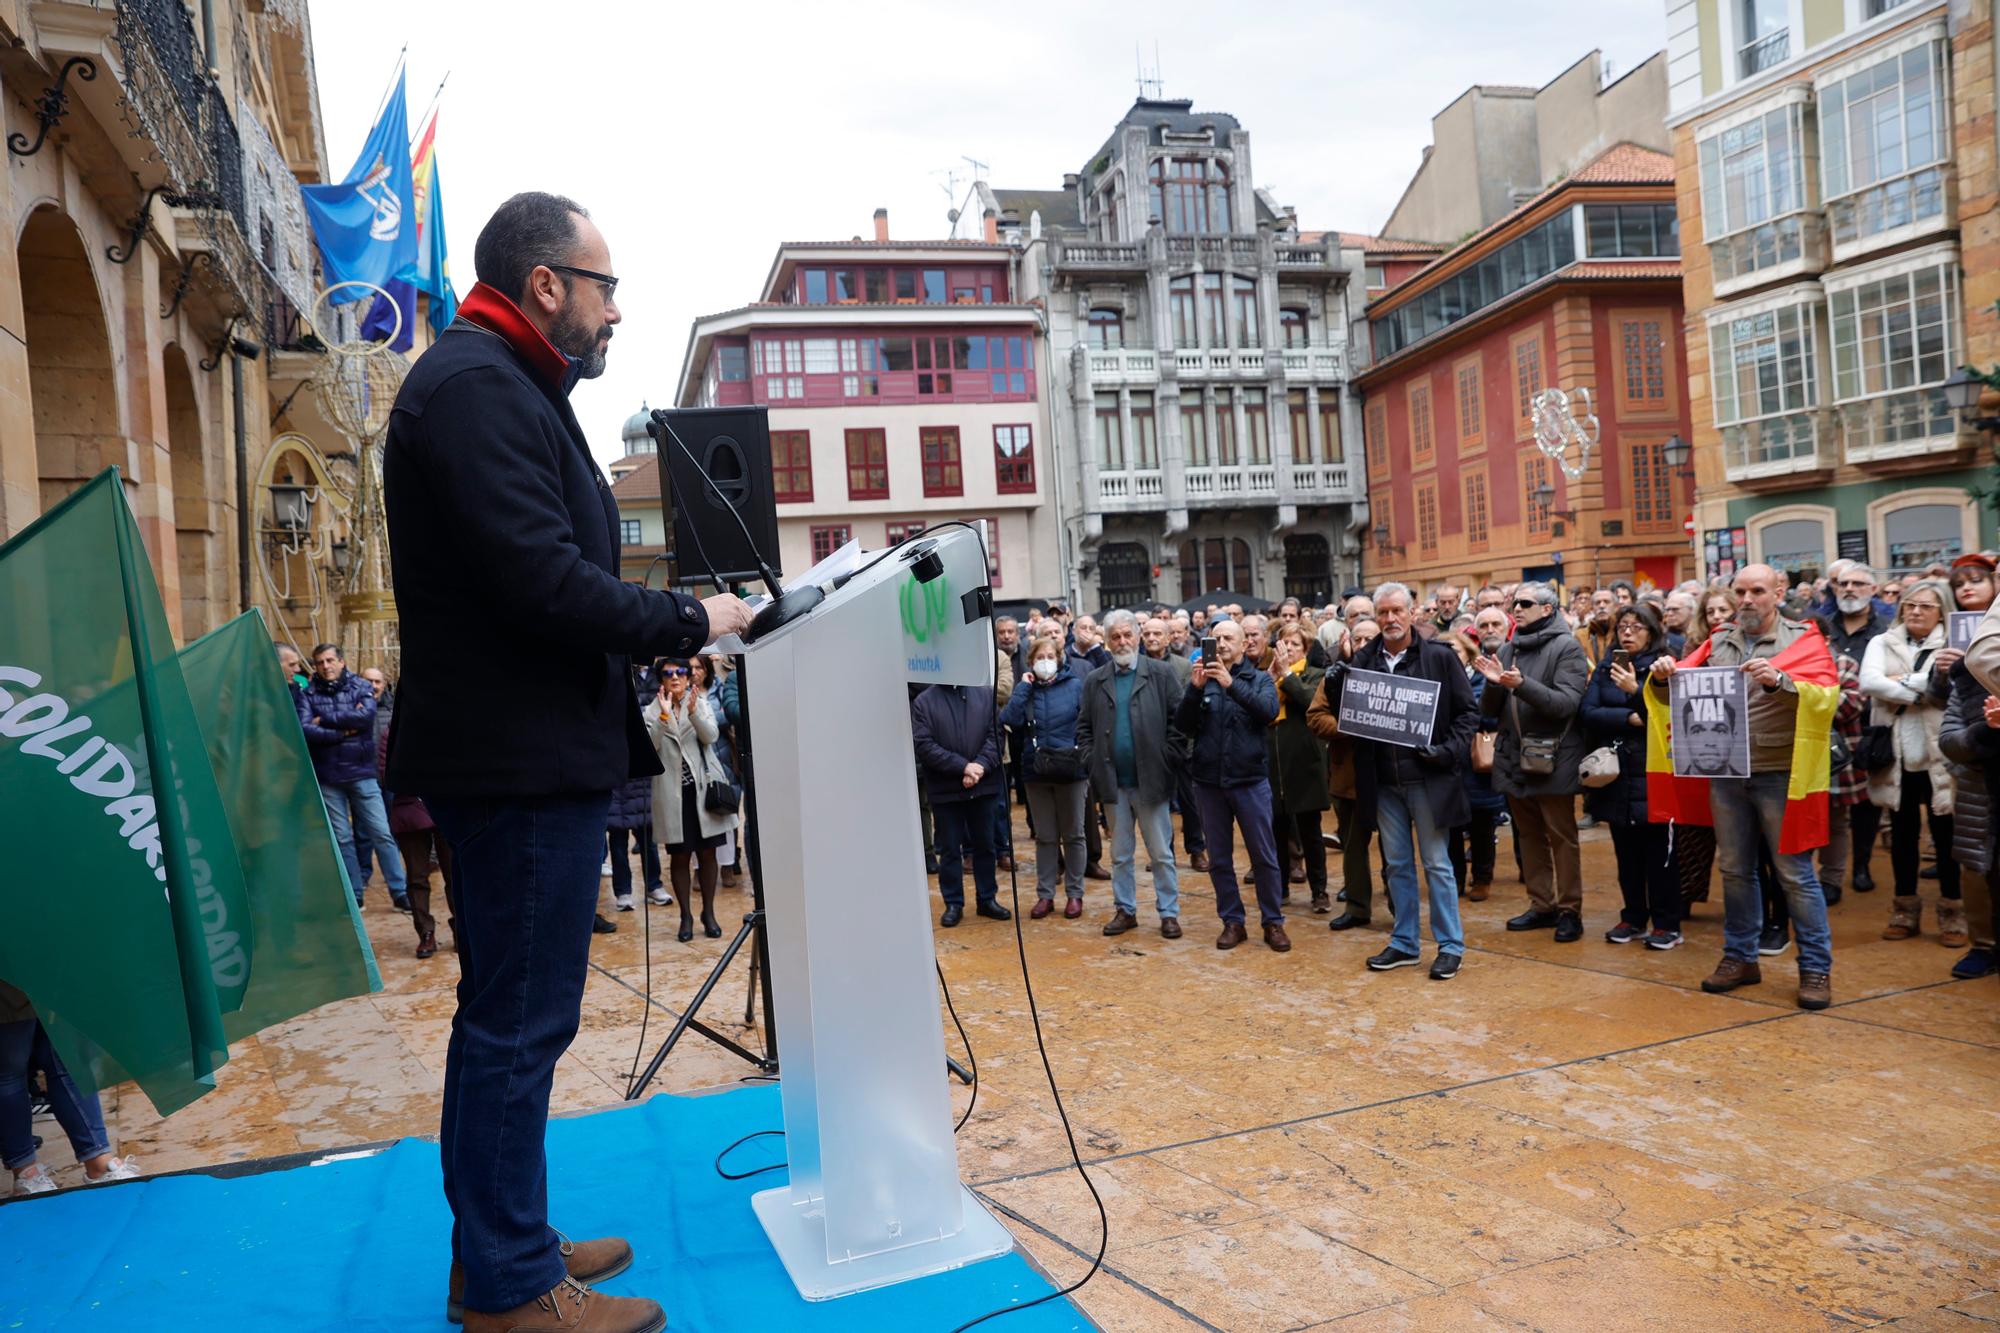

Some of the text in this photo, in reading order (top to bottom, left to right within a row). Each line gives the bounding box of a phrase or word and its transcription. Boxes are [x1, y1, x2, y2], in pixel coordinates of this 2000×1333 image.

[1394, 687, 1434, 705] QUIERE
[1679, 671, 1737, 699] ¡VETE
[1368, 697, 1408, 715] VOTAR!
[1689, 698, 1725, 722] YA!
[1341, 708, 1431, 736] ¡ELECCIONES YA!
